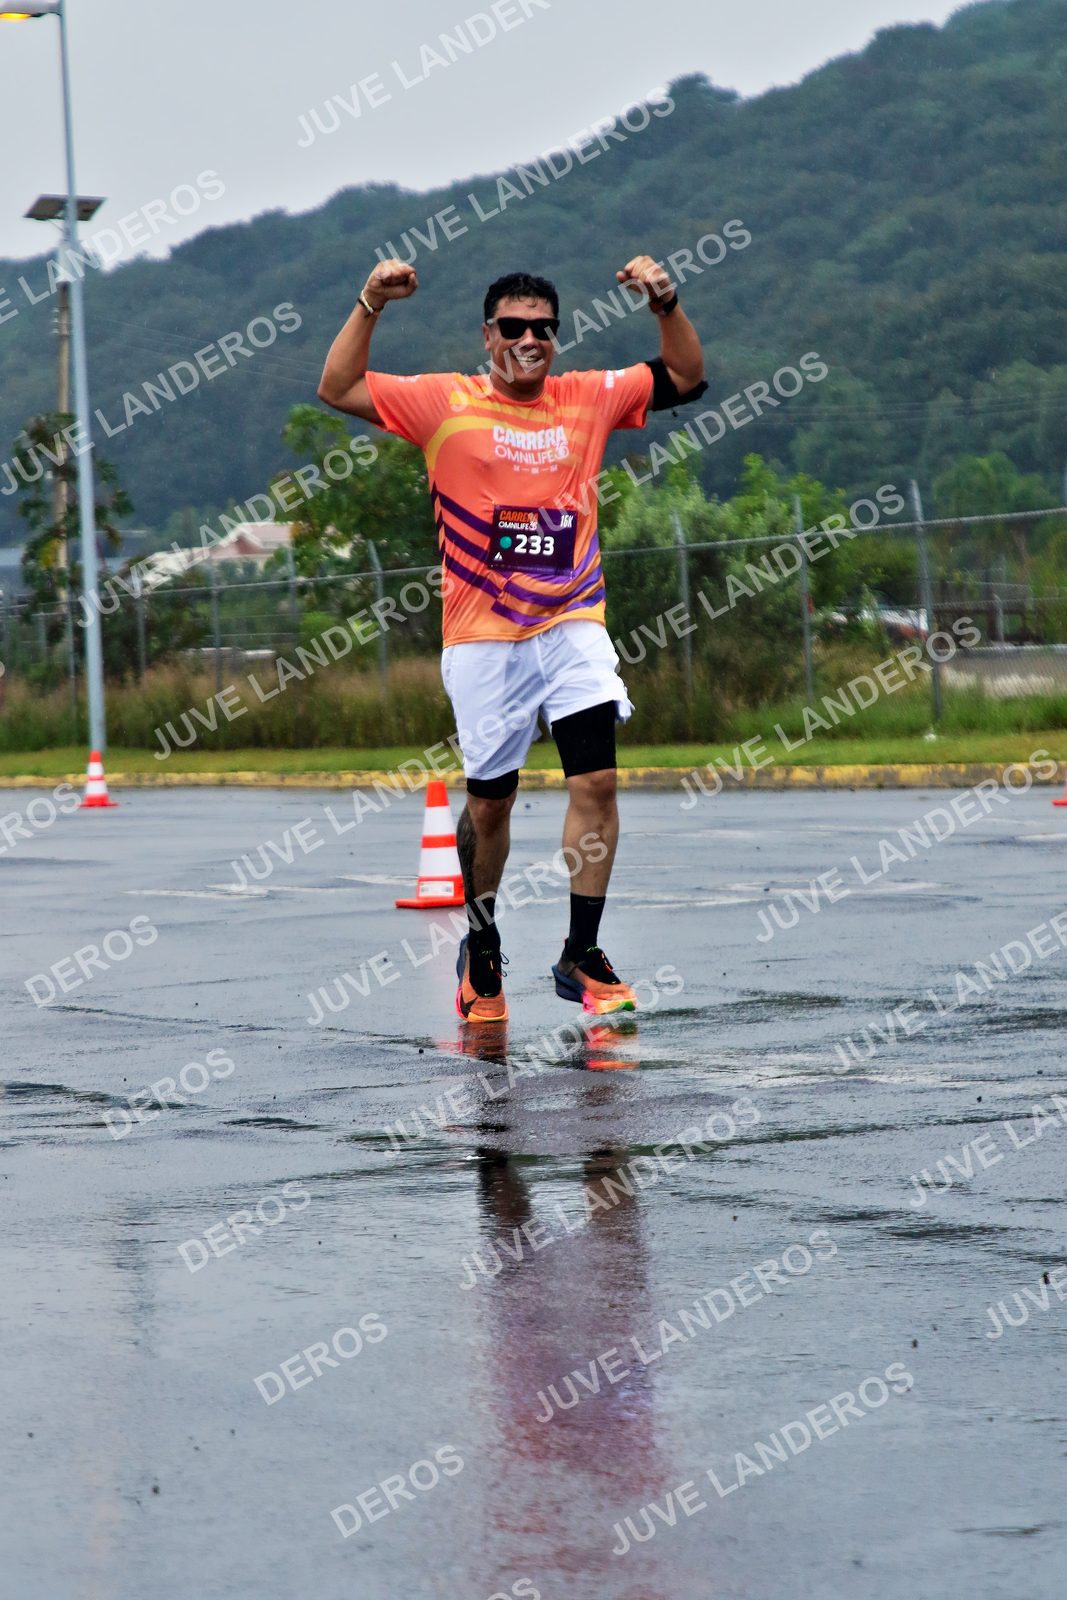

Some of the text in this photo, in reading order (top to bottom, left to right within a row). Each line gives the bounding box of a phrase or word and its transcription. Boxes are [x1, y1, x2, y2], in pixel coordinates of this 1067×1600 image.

[493, 424, 568, 450] CARRERA
[500, 510, 539, 522] CARRERA
[514, 533, 555, 556] 233
